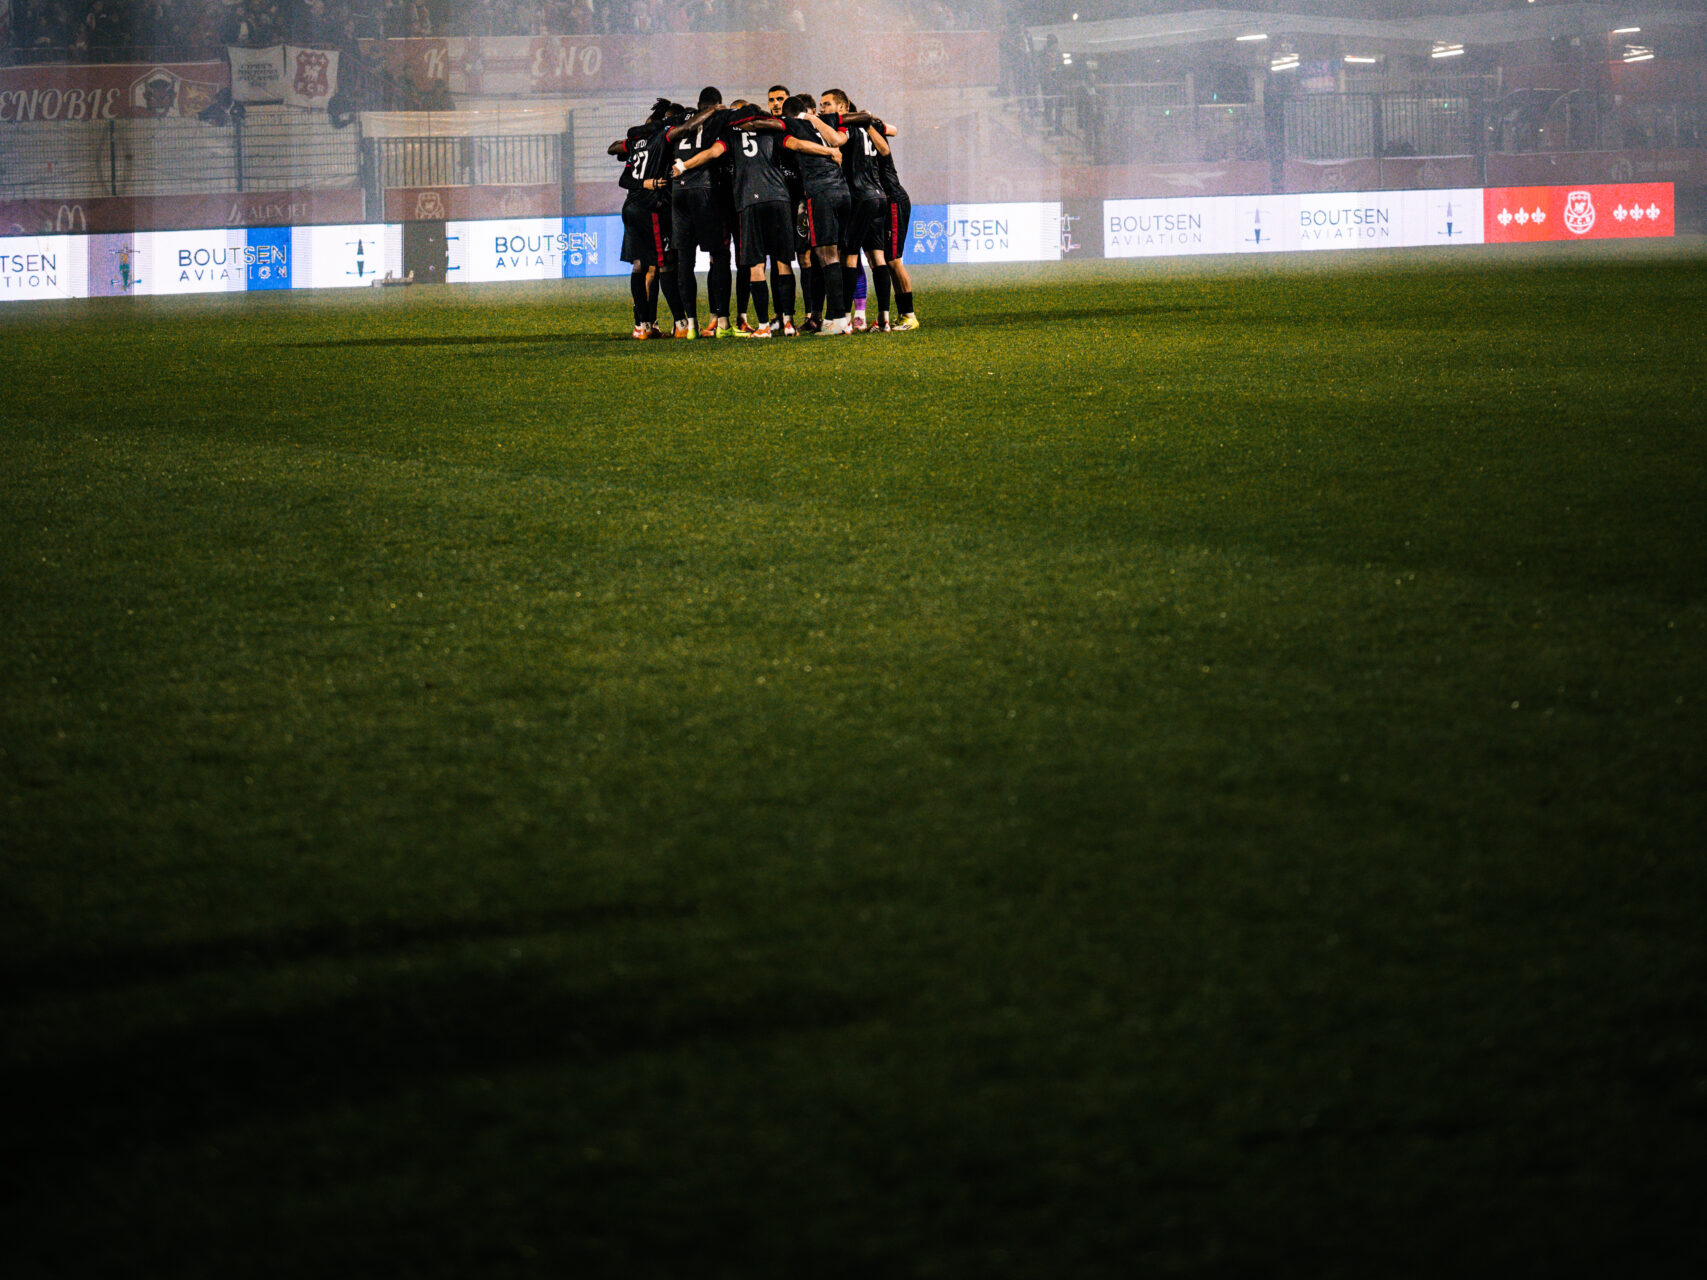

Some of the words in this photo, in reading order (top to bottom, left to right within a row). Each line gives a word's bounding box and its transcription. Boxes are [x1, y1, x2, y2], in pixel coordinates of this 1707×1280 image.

[741, 131, 759, 157] 5
[632, 150, 649, 180] 27
[1110, 214, 1201, 232] BOUTSEN
[1300, 208, 1389, 226] BOUTSEN
[913, 219, 1009, 239] BOUTSEN
[1301, 226, 1389, 240] AVIATION
[495, 232, 598, 254] BOUTSEN
[913, 238, 1009, 253] AVIATION
[1111, 232, 1202, 246] AVIATION
[179, 245, 287, 267] BOUTSEN
[496, 252, 598, 269] AVIATION
[4, 275, 57, 288] TION
[179, 265, 288, 283] AVIATION
